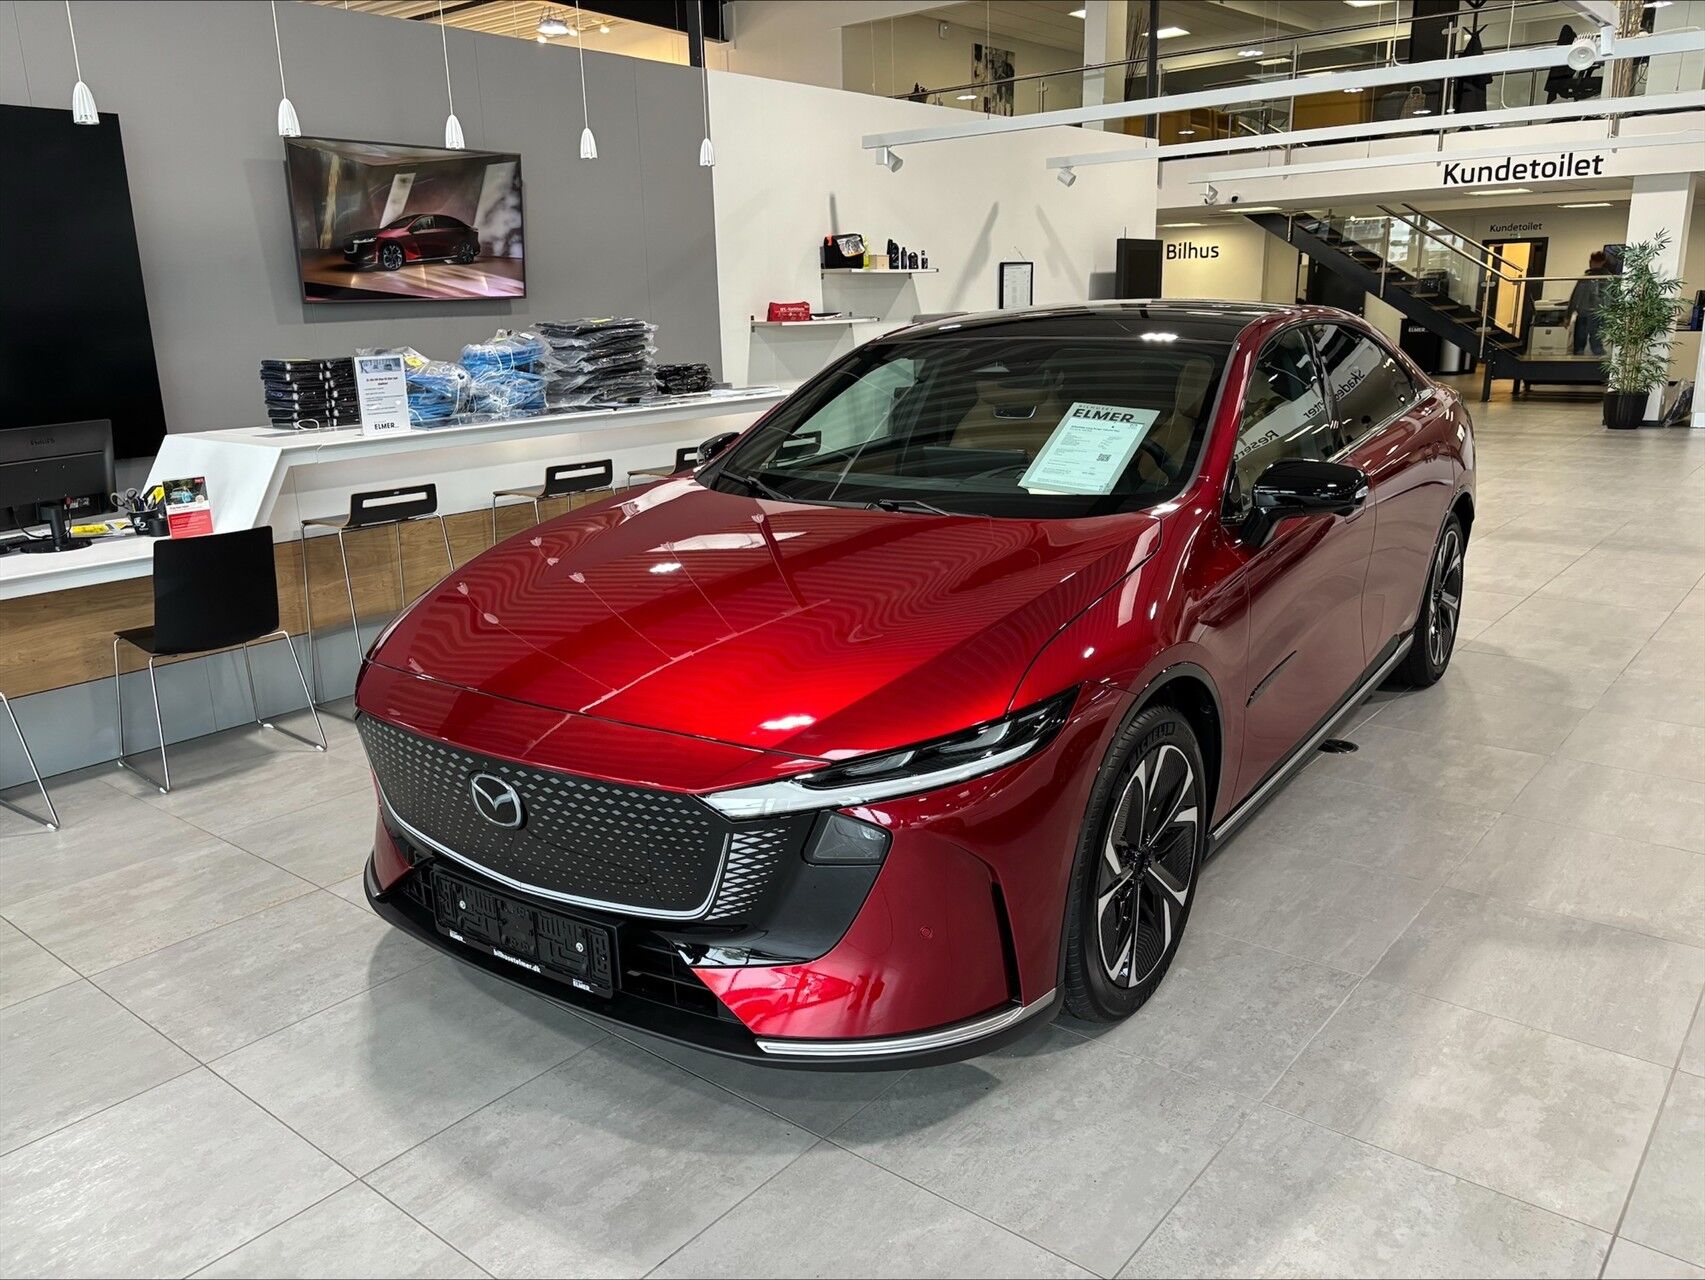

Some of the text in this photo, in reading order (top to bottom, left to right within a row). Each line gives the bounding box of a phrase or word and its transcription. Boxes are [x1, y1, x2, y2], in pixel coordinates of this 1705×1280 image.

[1443, 152, 1604, 185] Kundetoilet
[1489, 222, 1543, 232] Kundetoilet
[1166, 242, 1219, 260] Bilhus
[1072, 408, 1135, 423] ELMER
[374, 422, 395, 430] ELMER
